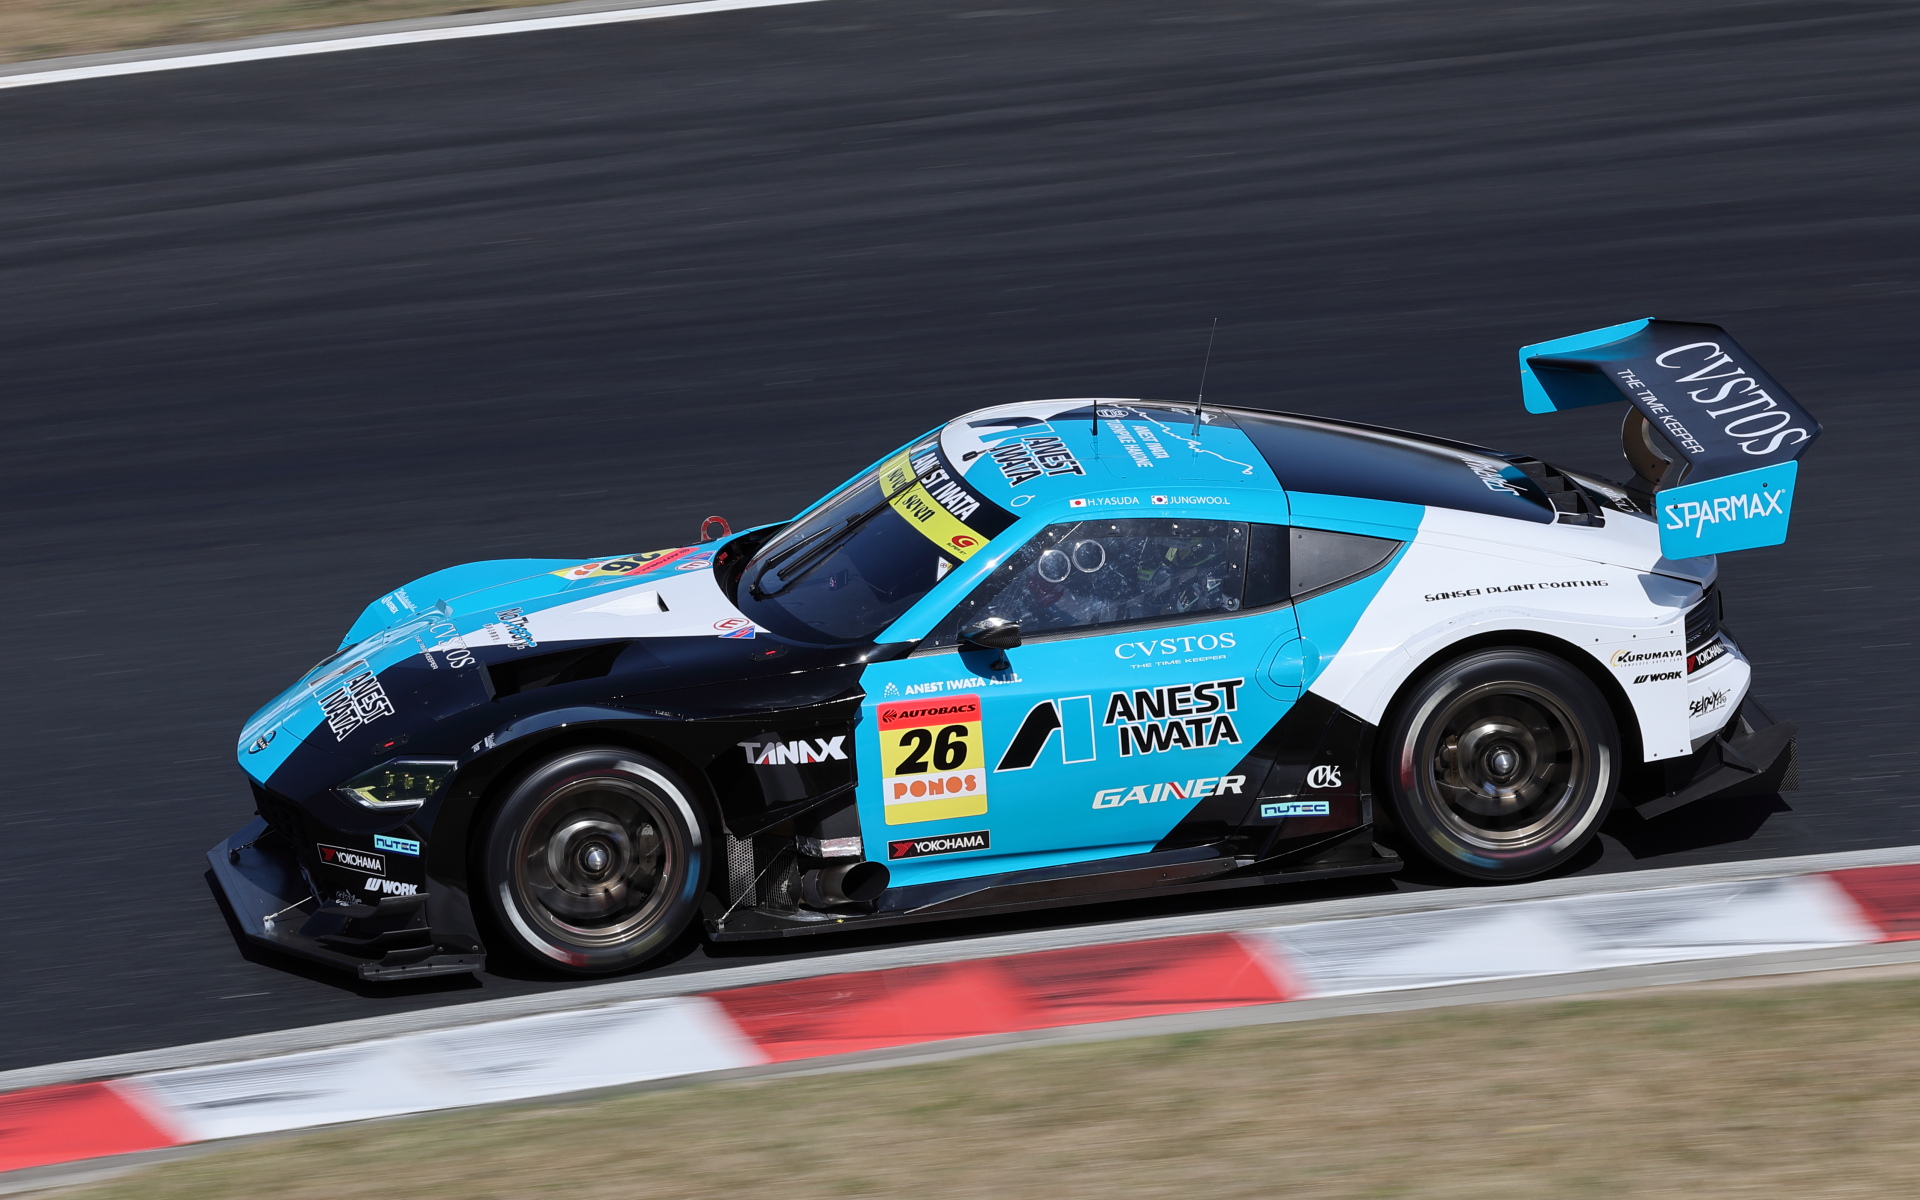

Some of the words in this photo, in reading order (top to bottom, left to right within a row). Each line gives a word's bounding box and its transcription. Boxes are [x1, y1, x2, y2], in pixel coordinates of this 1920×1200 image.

[1617, 368, 1646, 389] THE
[1637, 389, 1669, 414] TIME
[1659, 415, 1705, 454] KEEPER
[1656, 341, 1811, 455] CVSTOS
[987, 442, 1045, 488] IWATA
[1020, 436, 1087, 477] ANEST
[902, 494, 936, 523] seven
[931, 480, 980, 521] IWATA
[1088, 496, 1140, 506] H.YASUDA
[1169, 495, 1231, 505] JUNGWOO.L
[1664, 489, 1784, 539] SPARMAX
[1424, 588, 1482, 603] SANSEI
[429, 623, 477, 669] CVSTOS
[1114, 632, 1237, 660] CVSTOS
[1617, 649, 1683, 663] KURUMAYA
[1130, 662, 1153, 670] THE
[1155, 659, 1182, 667] TIME
[1184, 654, 1227, 664] KEEPER
[1650, 671, 1683, 683] WORK
[343, 669, 396, 725] ANEST
[904, 681, 944, 696] ANEST
[946, 676, 987, 691] IWATA
[317, 684, 364, 743] IWATA
[898, 703, 976, 720] AUTOBACS
[1102, 677, 1246, 728] ANEST
[736, 734, 850, 766] TANAX
[895, 725, 969, 776] 26
[1117, 713, 1243, 759] IWATA
[893, 774, 977, 800] PONOS
[1092, 774, 1247, 810] GAINER
[914, 835, 985, 854] YOKOHAMA
[335, 850, 383, 872] YOKOHAMA
[382, 879, 419, 897] WORK
